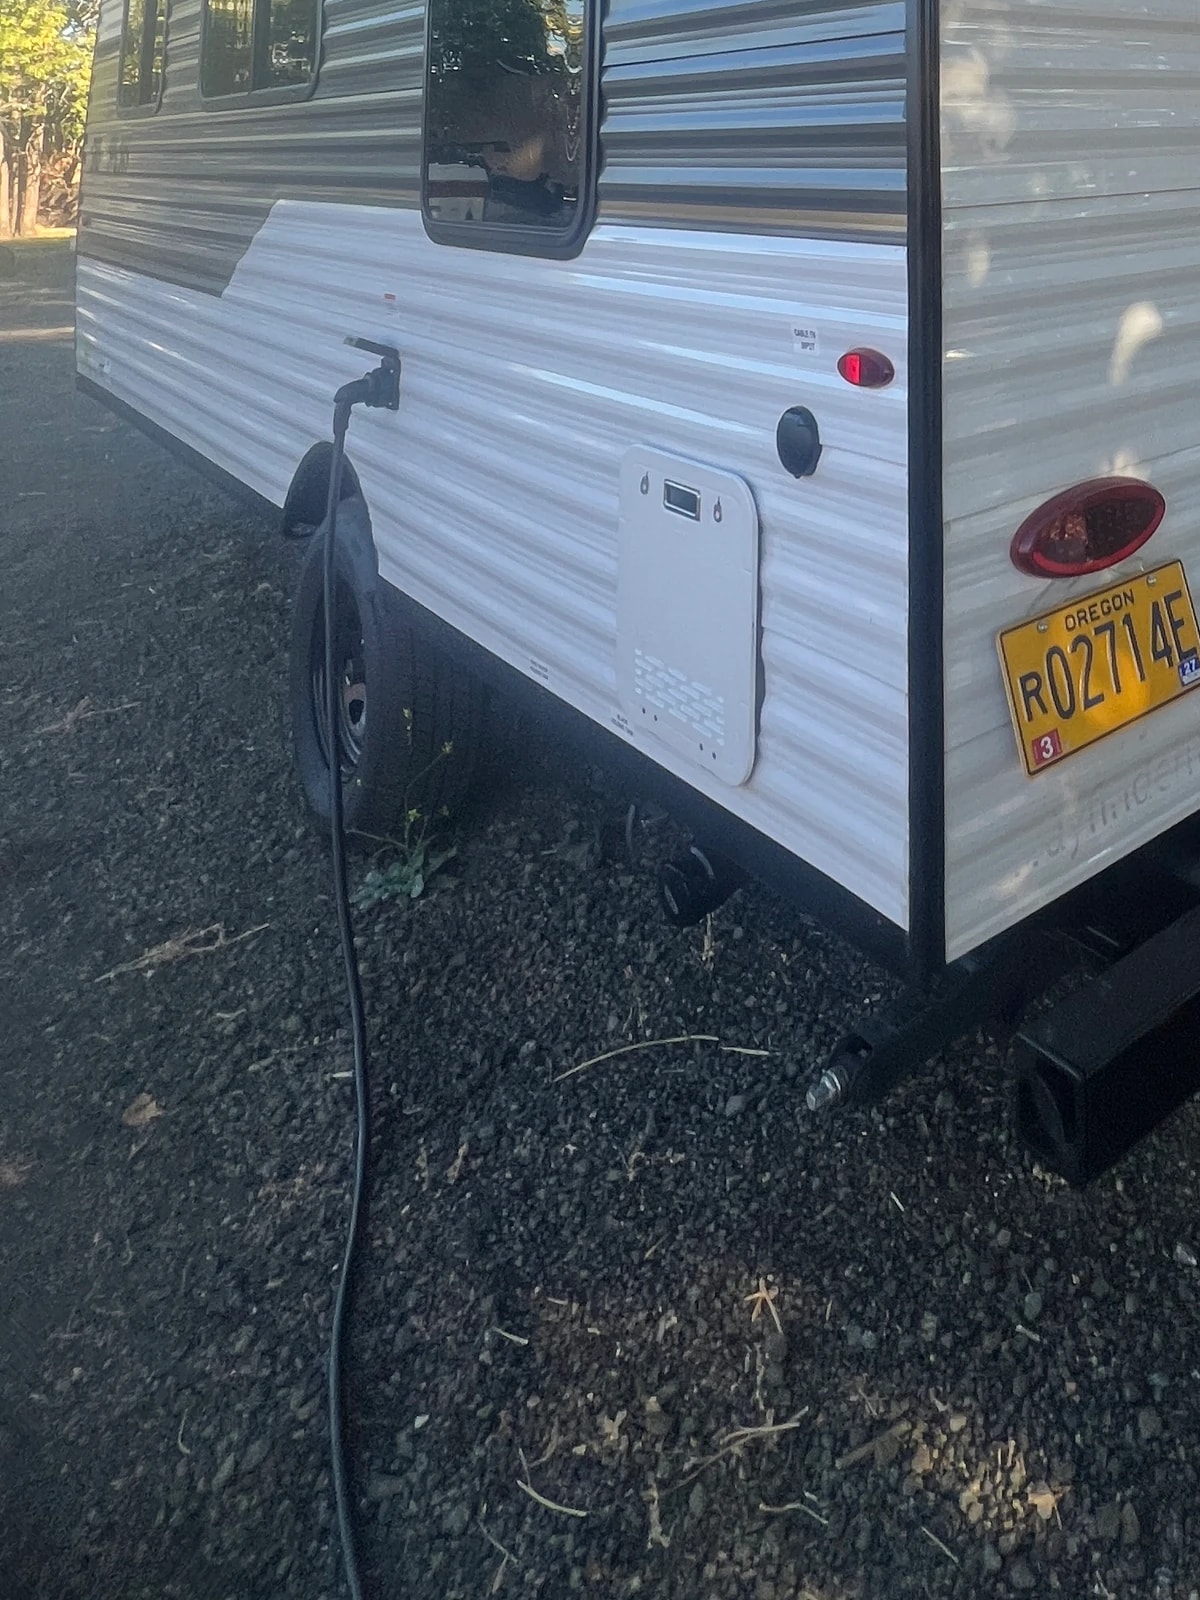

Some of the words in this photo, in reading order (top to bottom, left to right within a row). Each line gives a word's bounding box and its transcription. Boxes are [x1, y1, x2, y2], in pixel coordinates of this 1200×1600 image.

[1063, 588, 1136, 632] OREGON
[1018, 589, 1198, 723] R02714E
[1183, 658, 1197, 675] 27
[1040, 735, 1055, 759] 3
